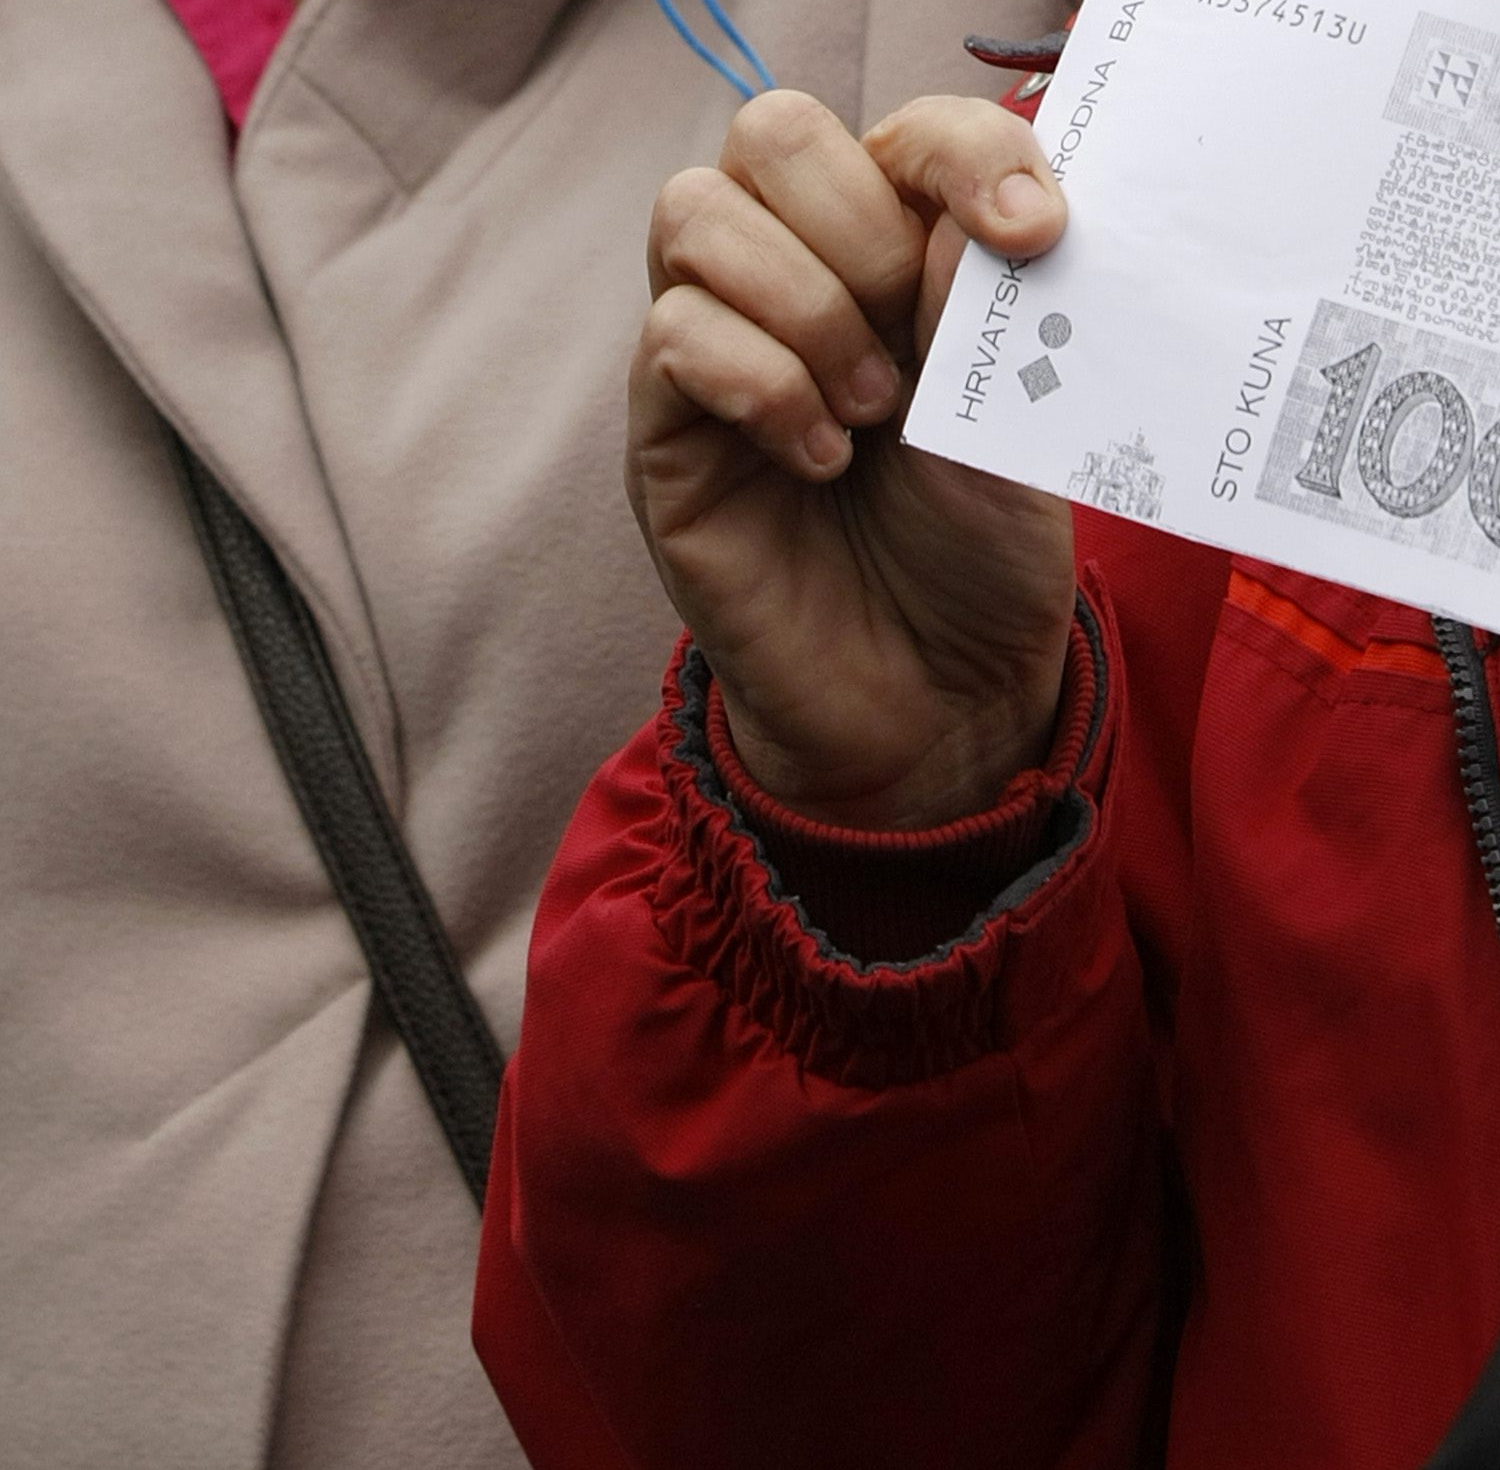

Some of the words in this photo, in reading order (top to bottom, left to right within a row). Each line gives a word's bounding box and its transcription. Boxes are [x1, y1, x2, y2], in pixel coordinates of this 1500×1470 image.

[955, 257, 1030, 423] HRVATSK
[1052, 58, 1117, 182] RODNA
[1211, 427, 1252, 502] STO
[1235, 316, 1293, 418] KUNA
